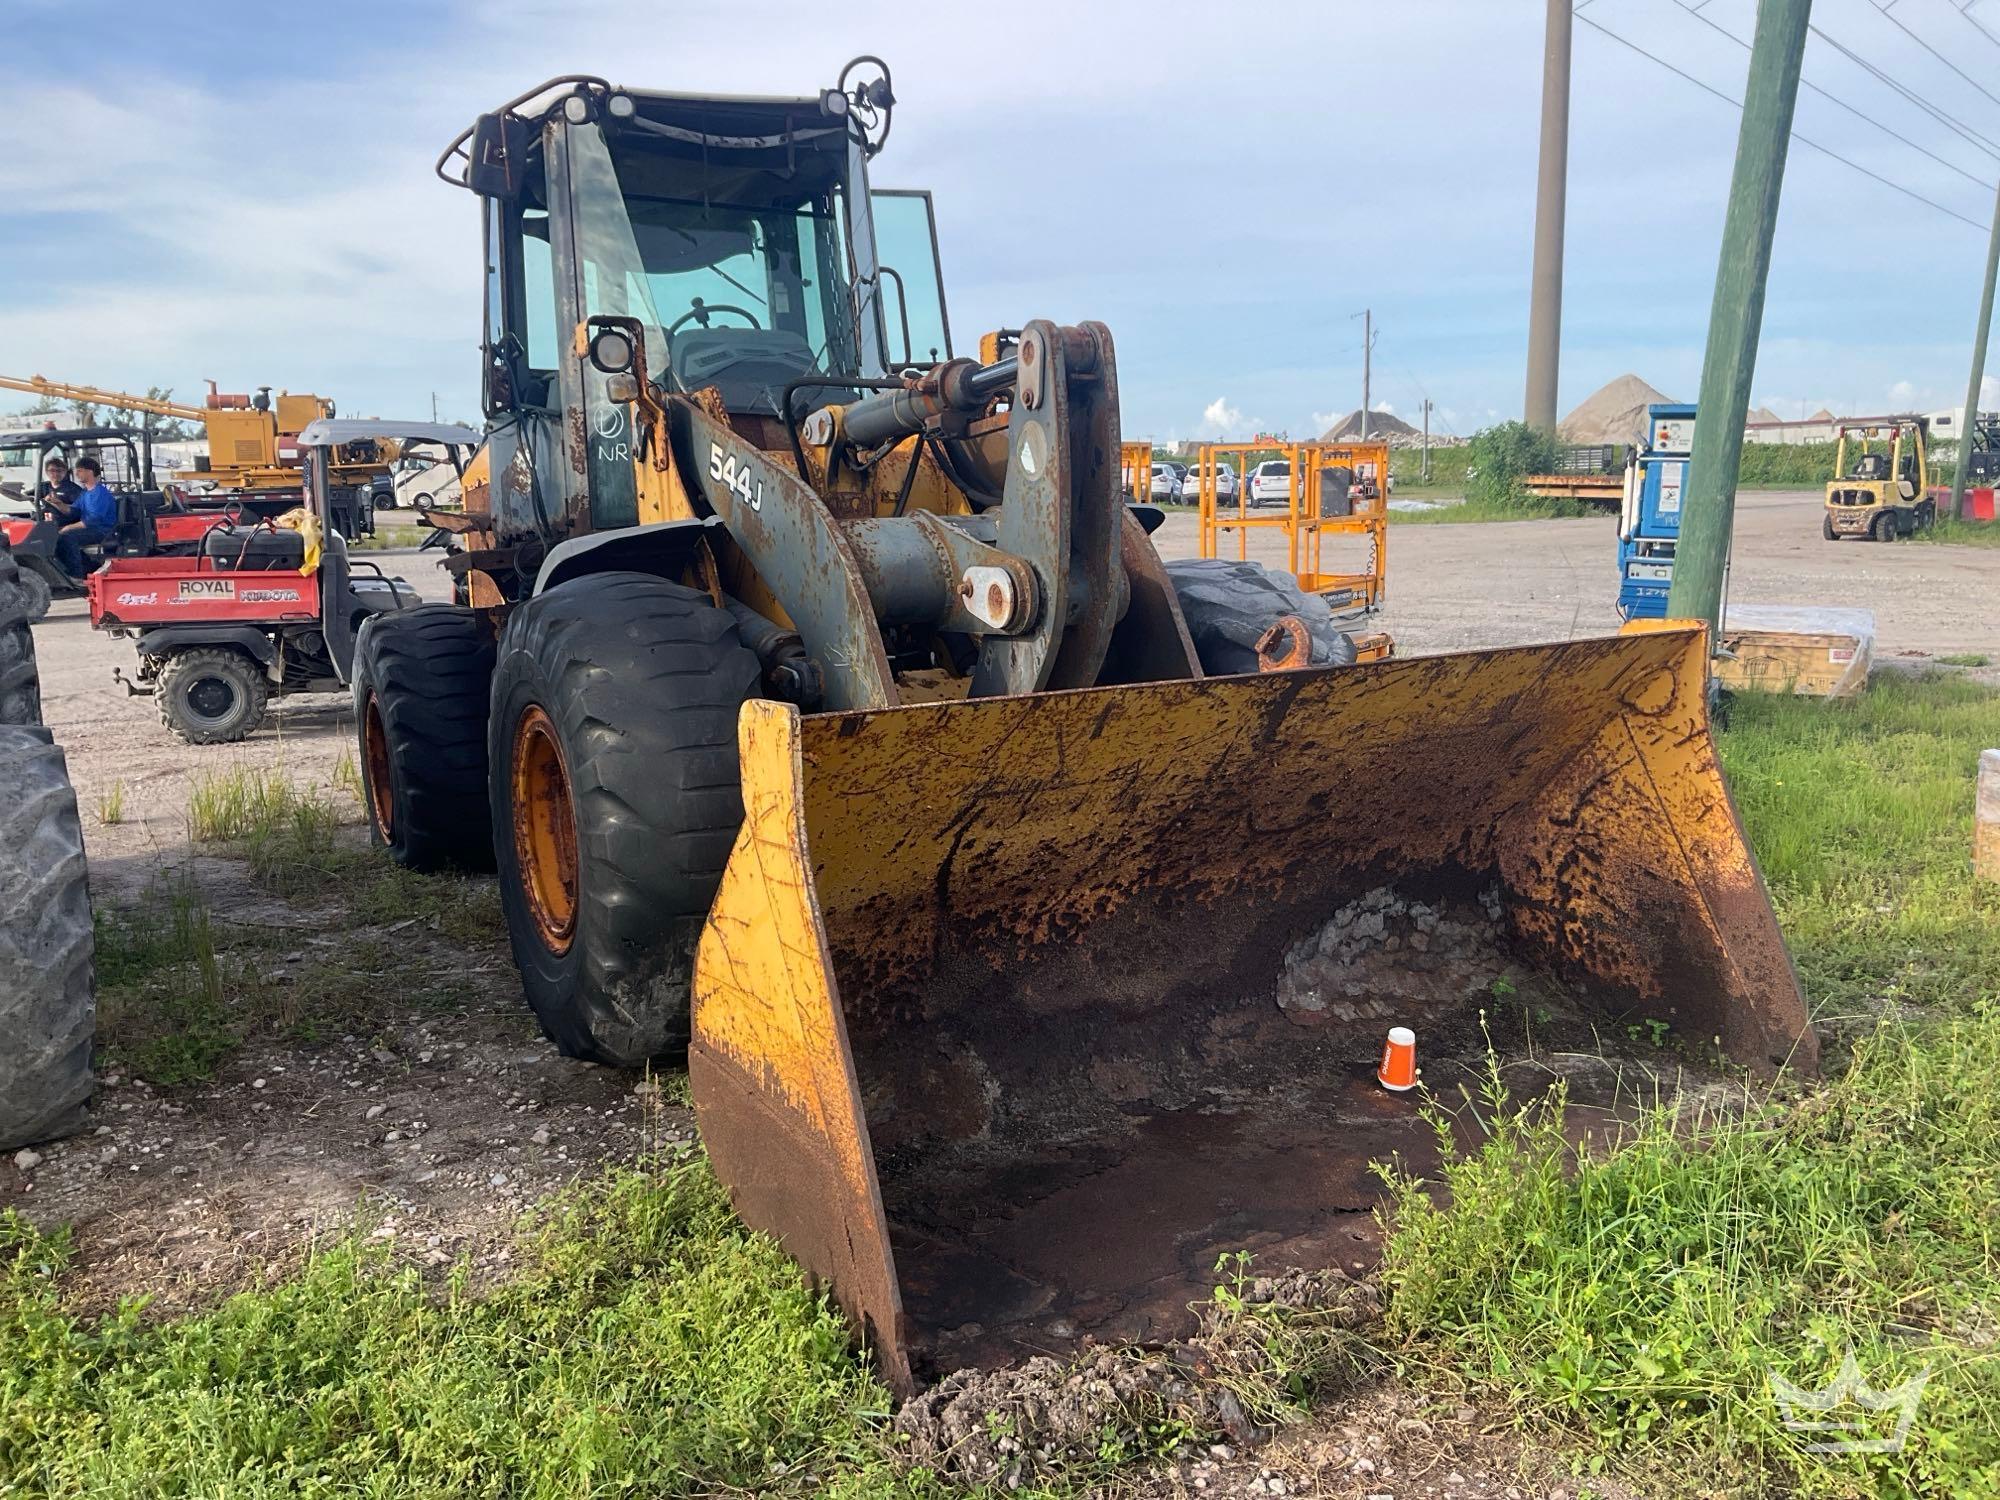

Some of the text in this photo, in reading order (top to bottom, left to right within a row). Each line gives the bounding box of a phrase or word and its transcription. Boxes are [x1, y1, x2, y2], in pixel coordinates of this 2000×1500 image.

[598, 443, 629, 462] NR
[709, 441, 765, 512] 544J
[180, 581, 234, 594] ROYAL
[240, 589, 300, 602] KUBOTA
